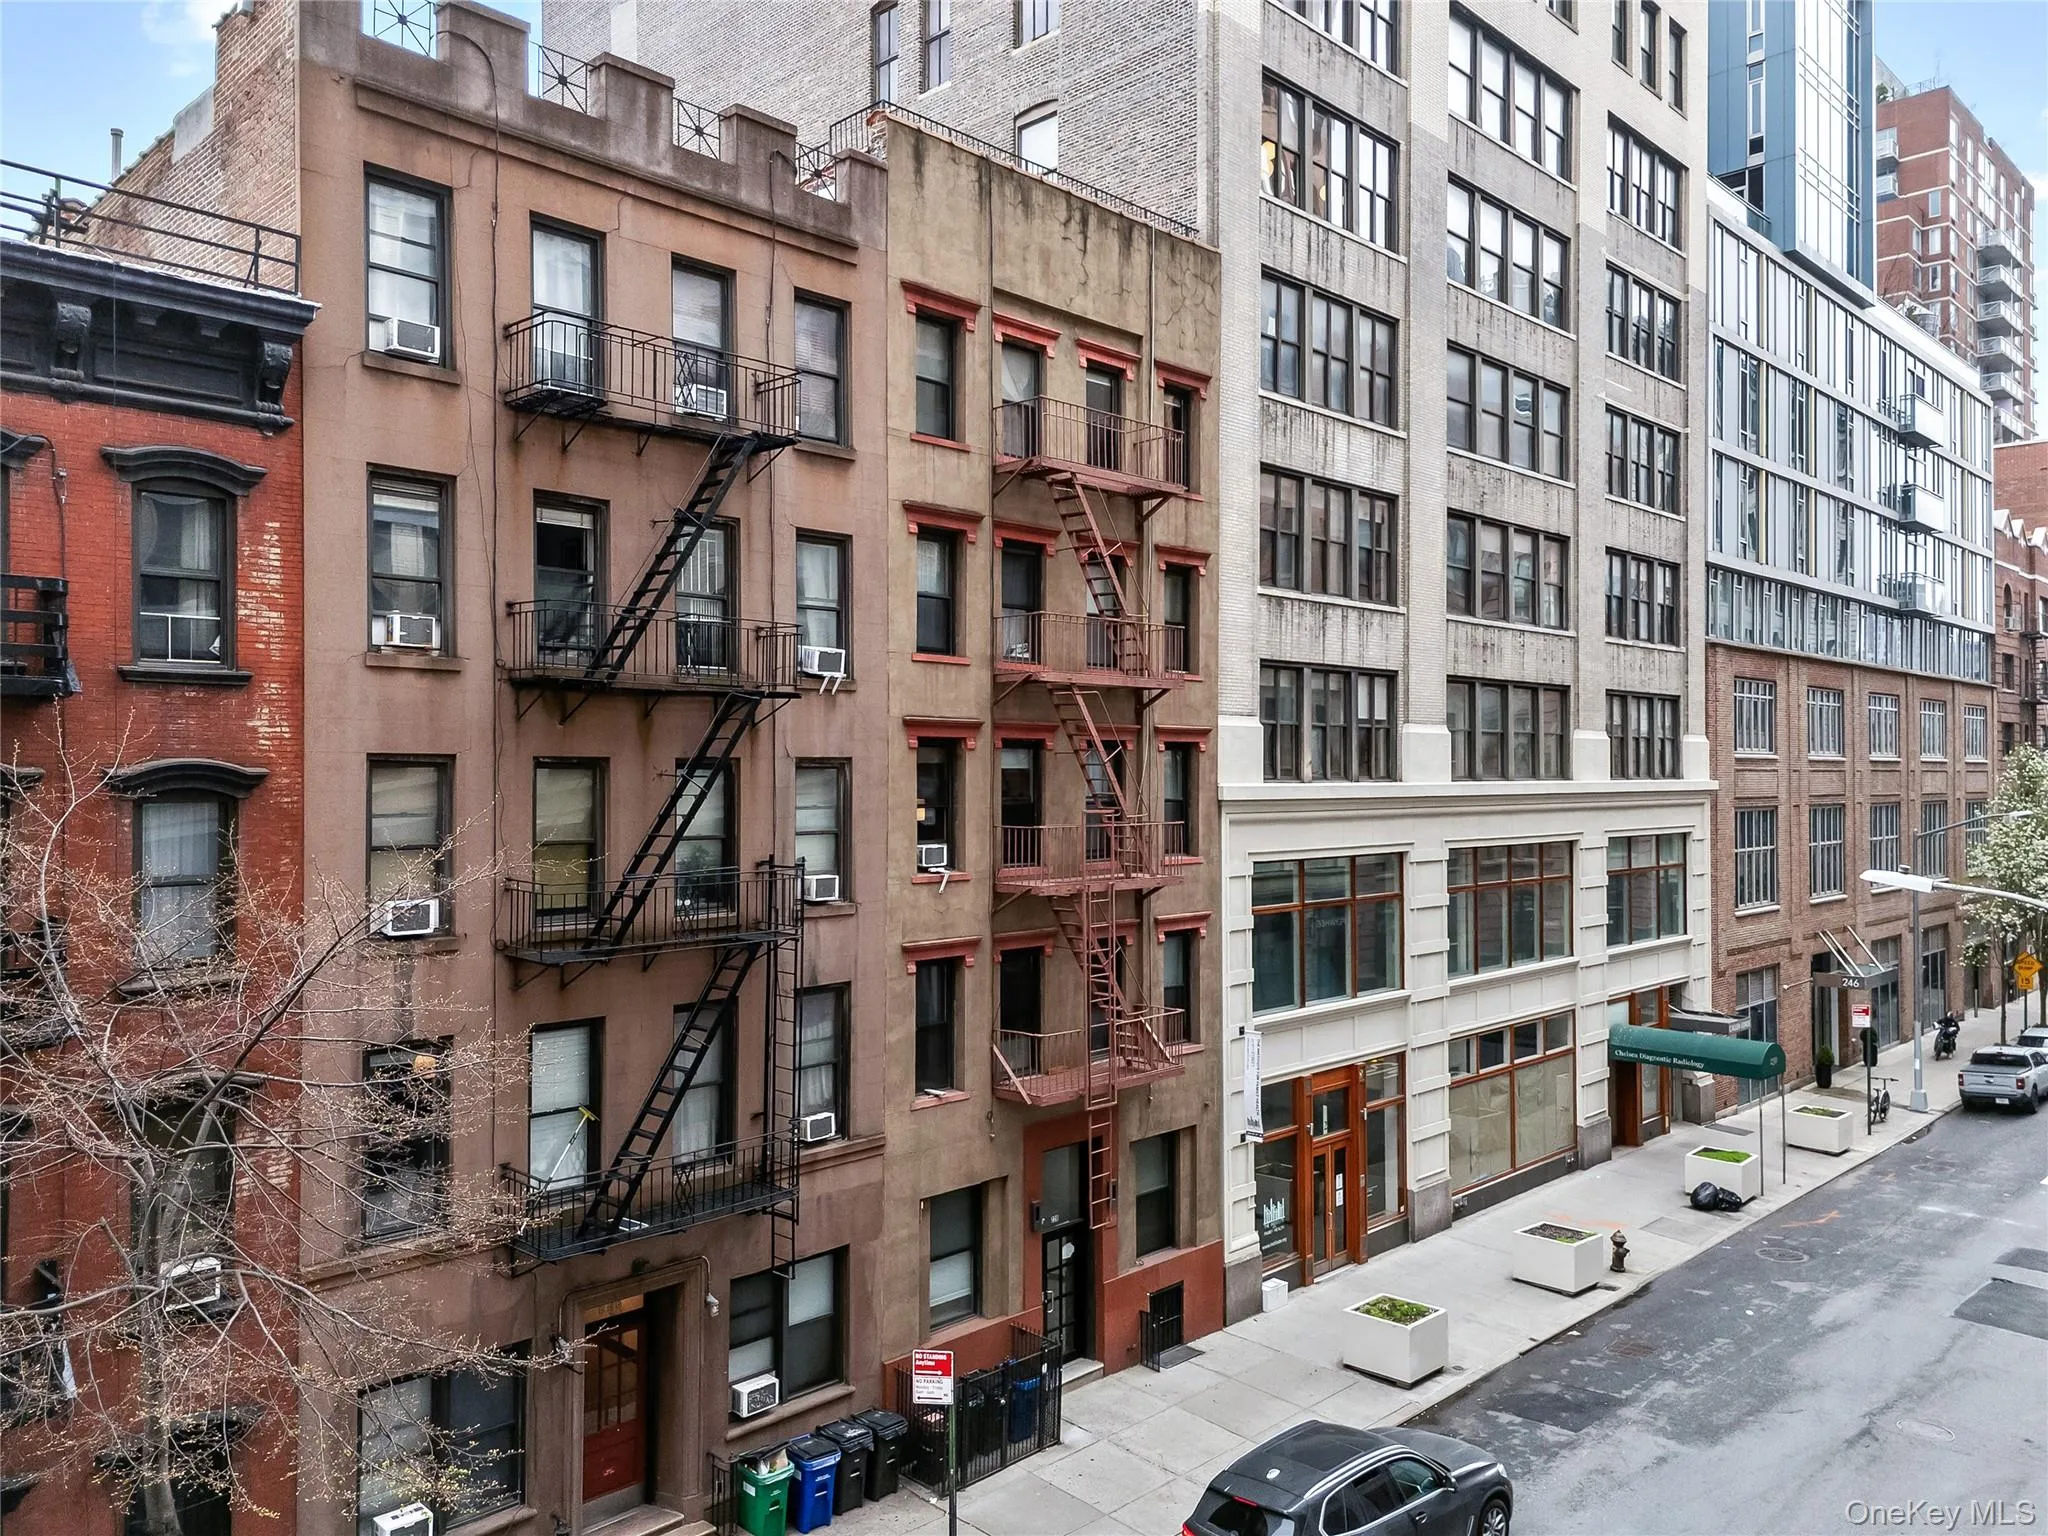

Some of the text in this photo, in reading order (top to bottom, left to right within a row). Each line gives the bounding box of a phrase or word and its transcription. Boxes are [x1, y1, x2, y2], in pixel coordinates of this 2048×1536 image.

[1842, 978, 1860, 988] 246
[1614, 1049, 1705, 1069] Chelsea Diagnostic Radiology
